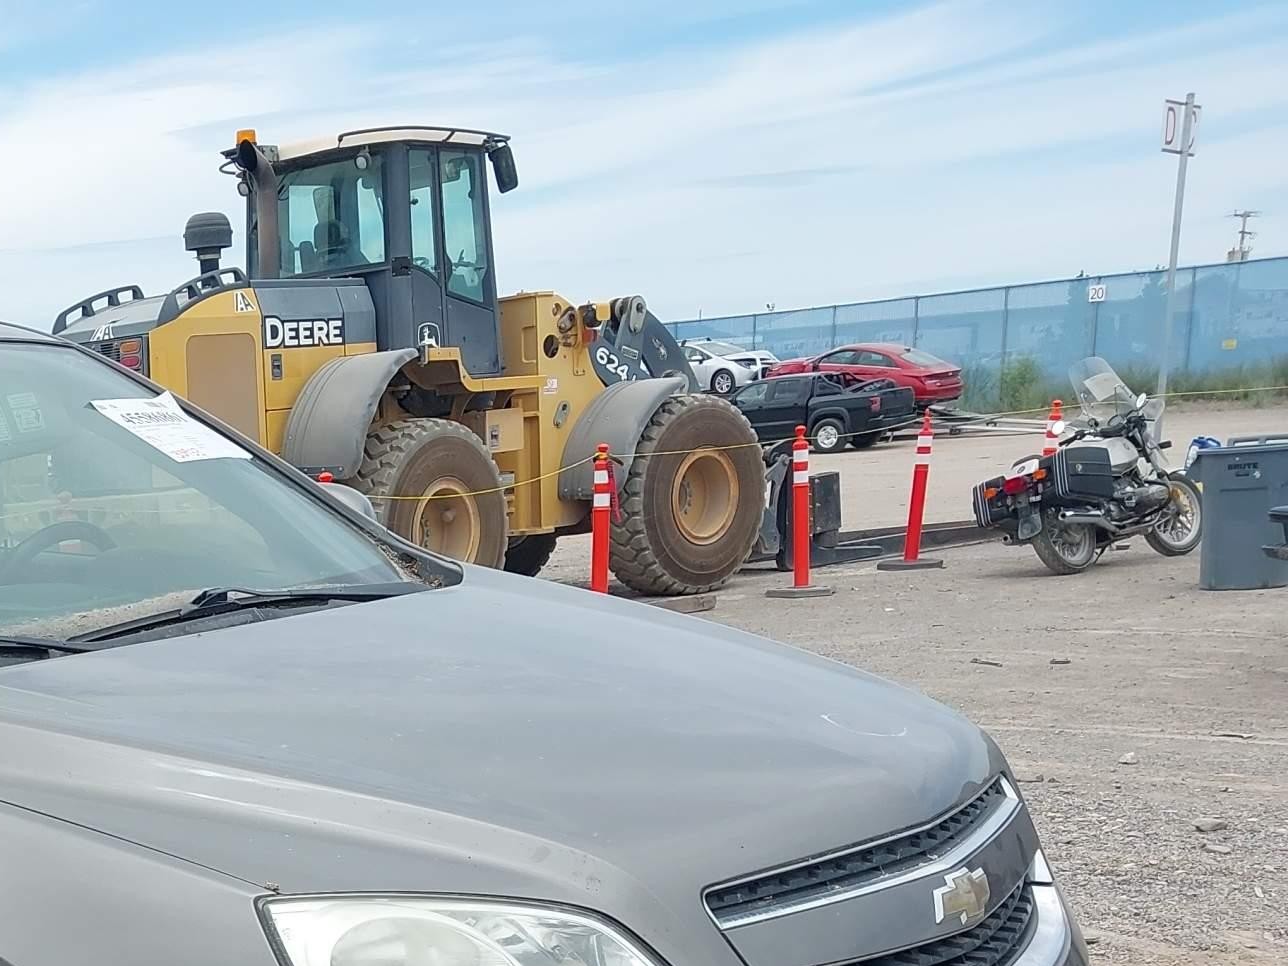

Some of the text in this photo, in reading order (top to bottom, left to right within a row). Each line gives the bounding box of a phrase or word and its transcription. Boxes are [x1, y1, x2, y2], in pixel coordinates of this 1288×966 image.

[1165, 106, 1176, 145] D
[1090, 287, 1104, 300] 20
[265, 317, 344, 348] DEERE
